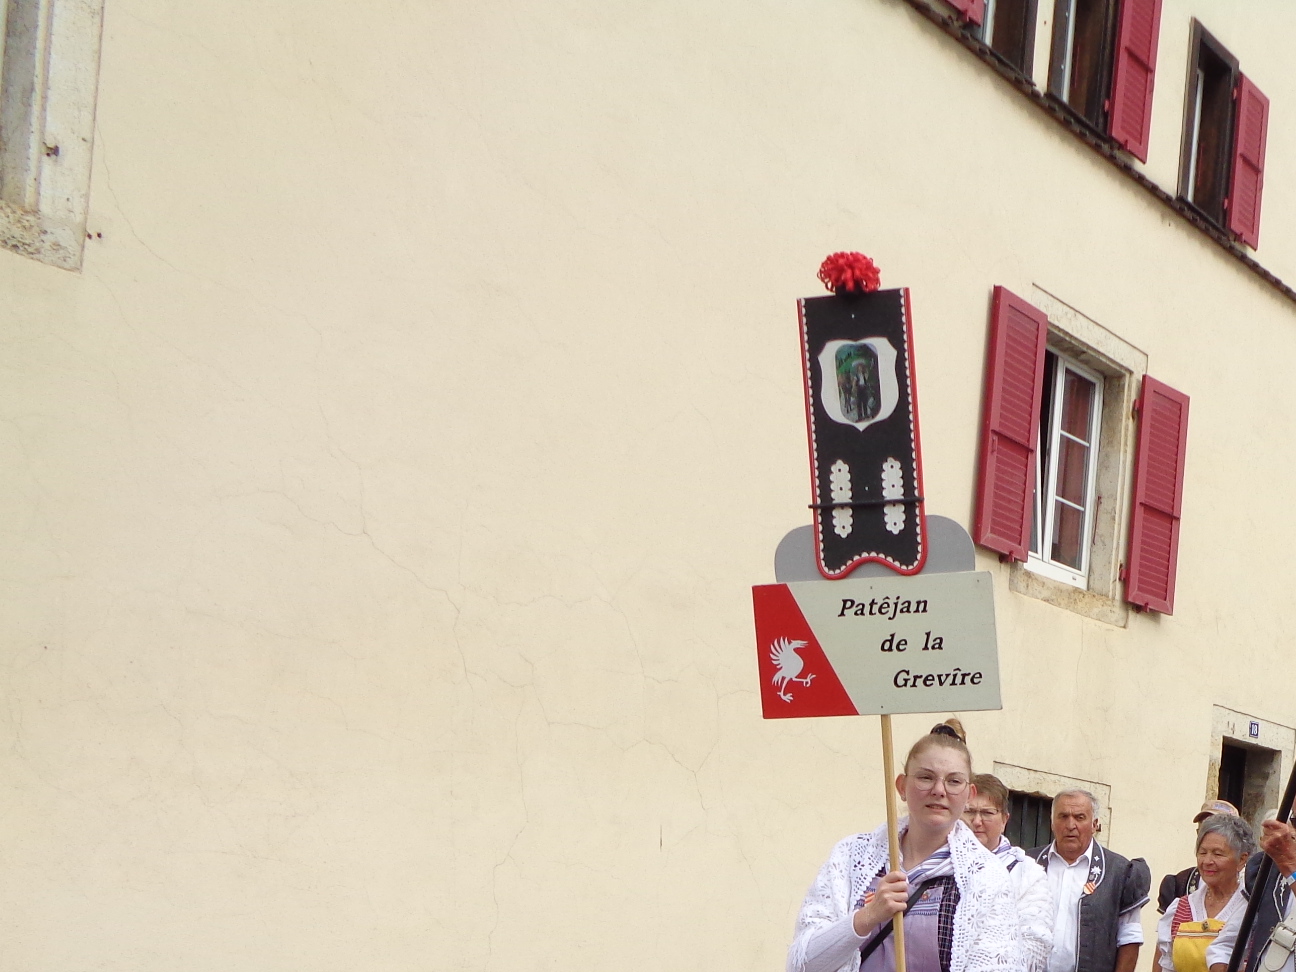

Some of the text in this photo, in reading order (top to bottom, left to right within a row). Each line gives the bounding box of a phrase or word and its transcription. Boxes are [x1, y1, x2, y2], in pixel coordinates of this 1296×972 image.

[838, 596, 928, 620] Patêjan
[880, 631, 944, 652] de la
[893, 668, 983, 688] Grevîre
